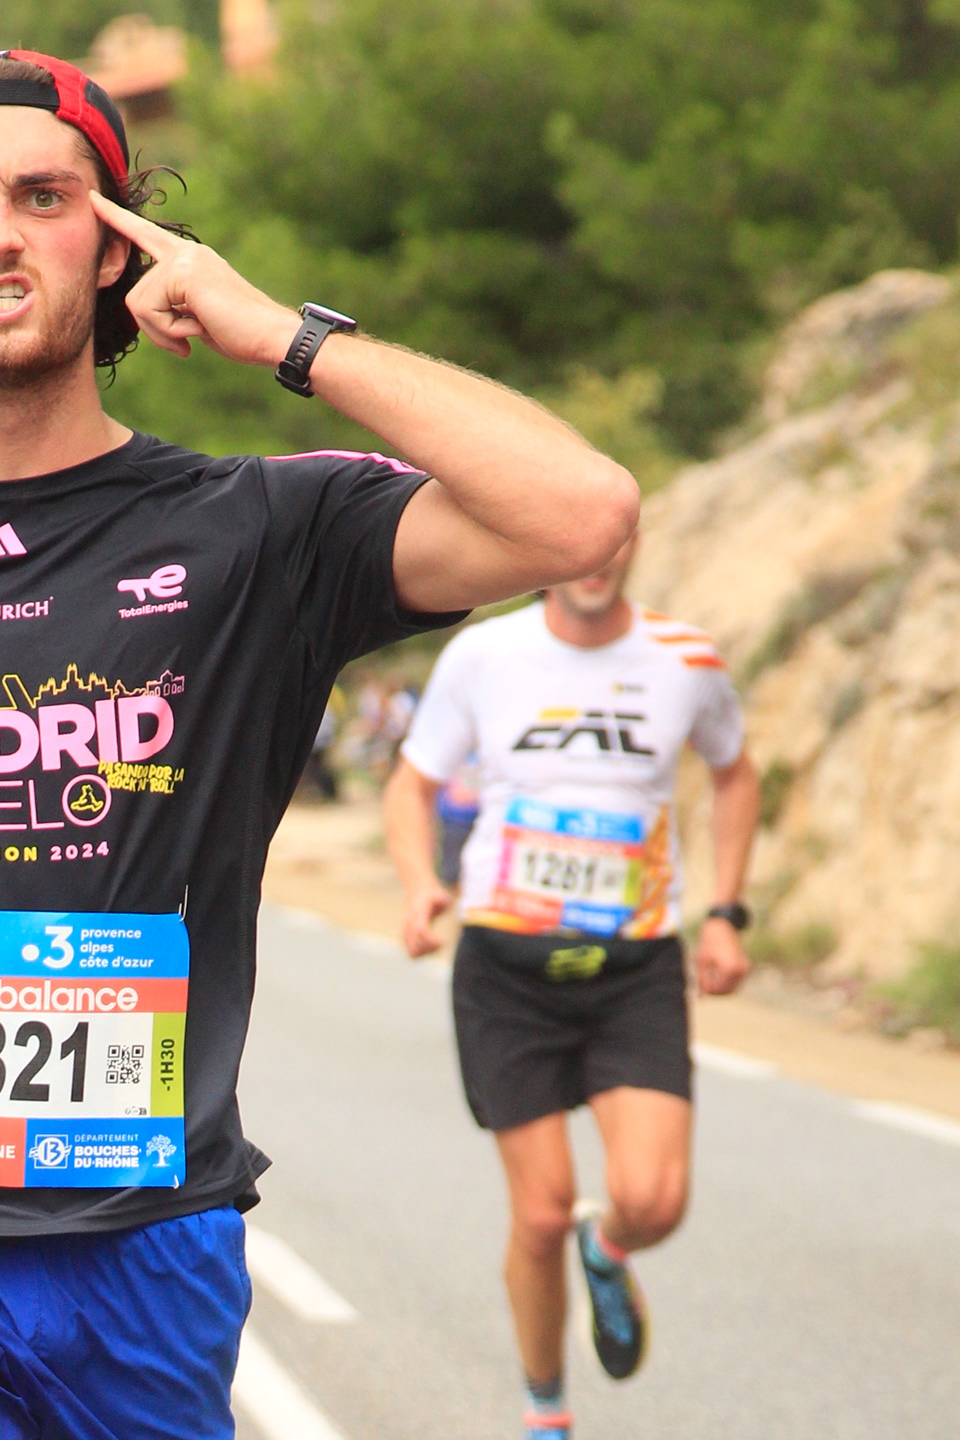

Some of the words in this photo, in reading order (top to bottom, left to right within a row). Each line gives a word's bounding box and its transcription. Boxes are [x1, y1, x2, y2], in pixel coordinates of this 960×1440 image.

[118, 600, 189, 619] TotalEnergies
[148, 764, 172, 780] POR
[149, 777, 174, 794] ROLL
[50, 841, 110, 861] 2024
[81, 928, 142, 940] provence
[80, 941, 114, 954] alpes
[79, 955, 109, 968] côte
[111, 956, 154, 968] d'azur
[161, 1038, 175, 1091] -1H30
[74, 1134, 139, 1142] DÉPARTEMENT
